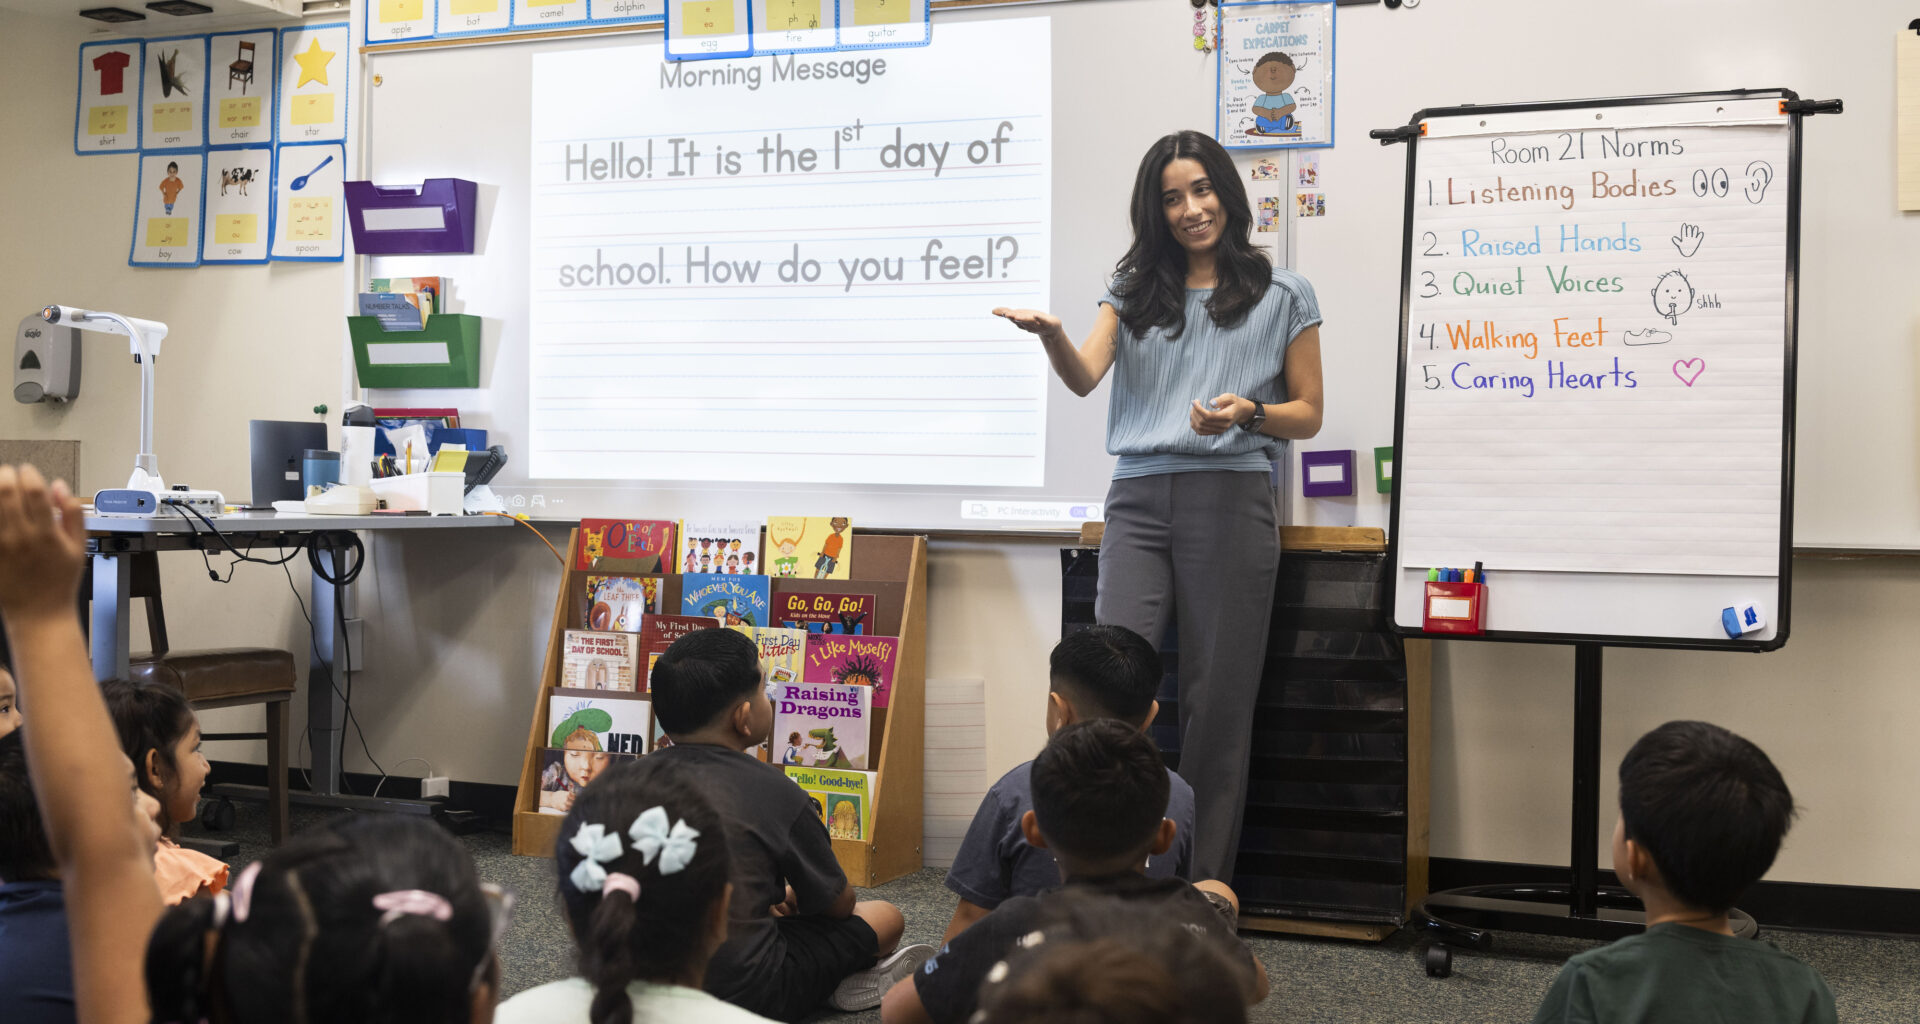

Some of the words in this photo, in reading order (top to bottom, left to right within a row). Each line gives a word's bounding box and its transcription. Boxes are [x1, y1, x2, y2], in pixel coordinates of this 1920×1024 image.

[540, 6, 564, 18] camel
[613, 2, 646, 15] dolphin
[466, 15, 481, 26] bat
[788, 14, 799, 27] ph
[1255, 21, 1290, 35] CARPET
[390, 22, 412, 40] apple
[786, 31, 803, 42] fire
[868, 26, 897, 43] guitar
[700, 40, 718, 52] egg
[660, 58, 762, 91] Morning
[772, 53, 887, 85] Message
[230, 128, 249, 139] chair
[304, 126, 320, 136] star
[99, 135, 116, 146] shirt
[1491, 137, 1549, 165] Room
[1558, 132, 1585, 162] 21
[1601, 130, 1684, 160] Norms
[565, 138, 653, 183] Hello!
[667, 138, 701, 177] It
[716, 145, 742, 176] is
[757, 133, 818, 174] the
[880, 127, 950, 178] day
[967, 121, 1014, 165] of
[1427, 179, 1439, 207] 1.
[1447, 176, 1575, 210] Listening
[1591, 169, 1677, 200] Bodies
[1422, 231, 1450, 257] 2.
[1461, 225, 1541, 257] Raised
[1559, 221, 1642, 253] Hands
[158, 247, 173, 261] boy
[295, 246, 320, 256] spoon
[559, 247, 671, 288] school.
[686, 245, 762, 284] How
[777, 243, 822, 284] do
[838, 256, 904, 293] you
[920, 235, 1020, 281] feel?
[1420, 271, 1442, 298] 3.
[1452, 266, 1526, 297] Quiet
[1546, 265, 1625, 295] Voices
[1696, 293, 1722, 310] shhh
[1419, 322, 1440, 350] 4.
[1446, 319, 1539, 359] Walking
[1553, 316, 1609, 348] Feet
[1422, 364, 1445, 391] 5.
[1451, 361, 1535, 398] Caring
[1547, 356, 1638, 390] Hearts
[997, 506, 1009, 514] PC
[1011, 506, 1061, 518] Interactivity
[607, 521, 640, 549] One
[641, 522, 657, 537] of
[627, 534, 654, 553] Each
[603, 592, 620, 601] LEAF
[621, 592, 640, 601] THIEF
[684, 582, 729, 607] WHOEVER
[729, 581, 748, 597] YOU
[748, 590, 767, 611] ARE
[787, 595, 809, 612] Go,
[813, 596, 835, 613] Go,
[839, 597, 864, 613] Go!
[655, 621, 668, 632] My
[670, 621, 689, 631] First
[581, 637, 594, 645] THE
[595, 638, 615, 646] FIRST
[755, 633, 778, 646] First
[781, 634, 801, 650] Day
[571, 645, 584, 653] DAY
[595, 647, 623, 657] SCHOOL
[759, 643, 796, 660] Jitters
[810, 653, 821, 667] I
[819, 640, 848, 660] Like
[847, 639, 892, 662] Myself!
[784, 685, 859, 706] Raising
[779, 701, 862, 720] Dragons
[818, 774, 864, 789] Good-bye!
